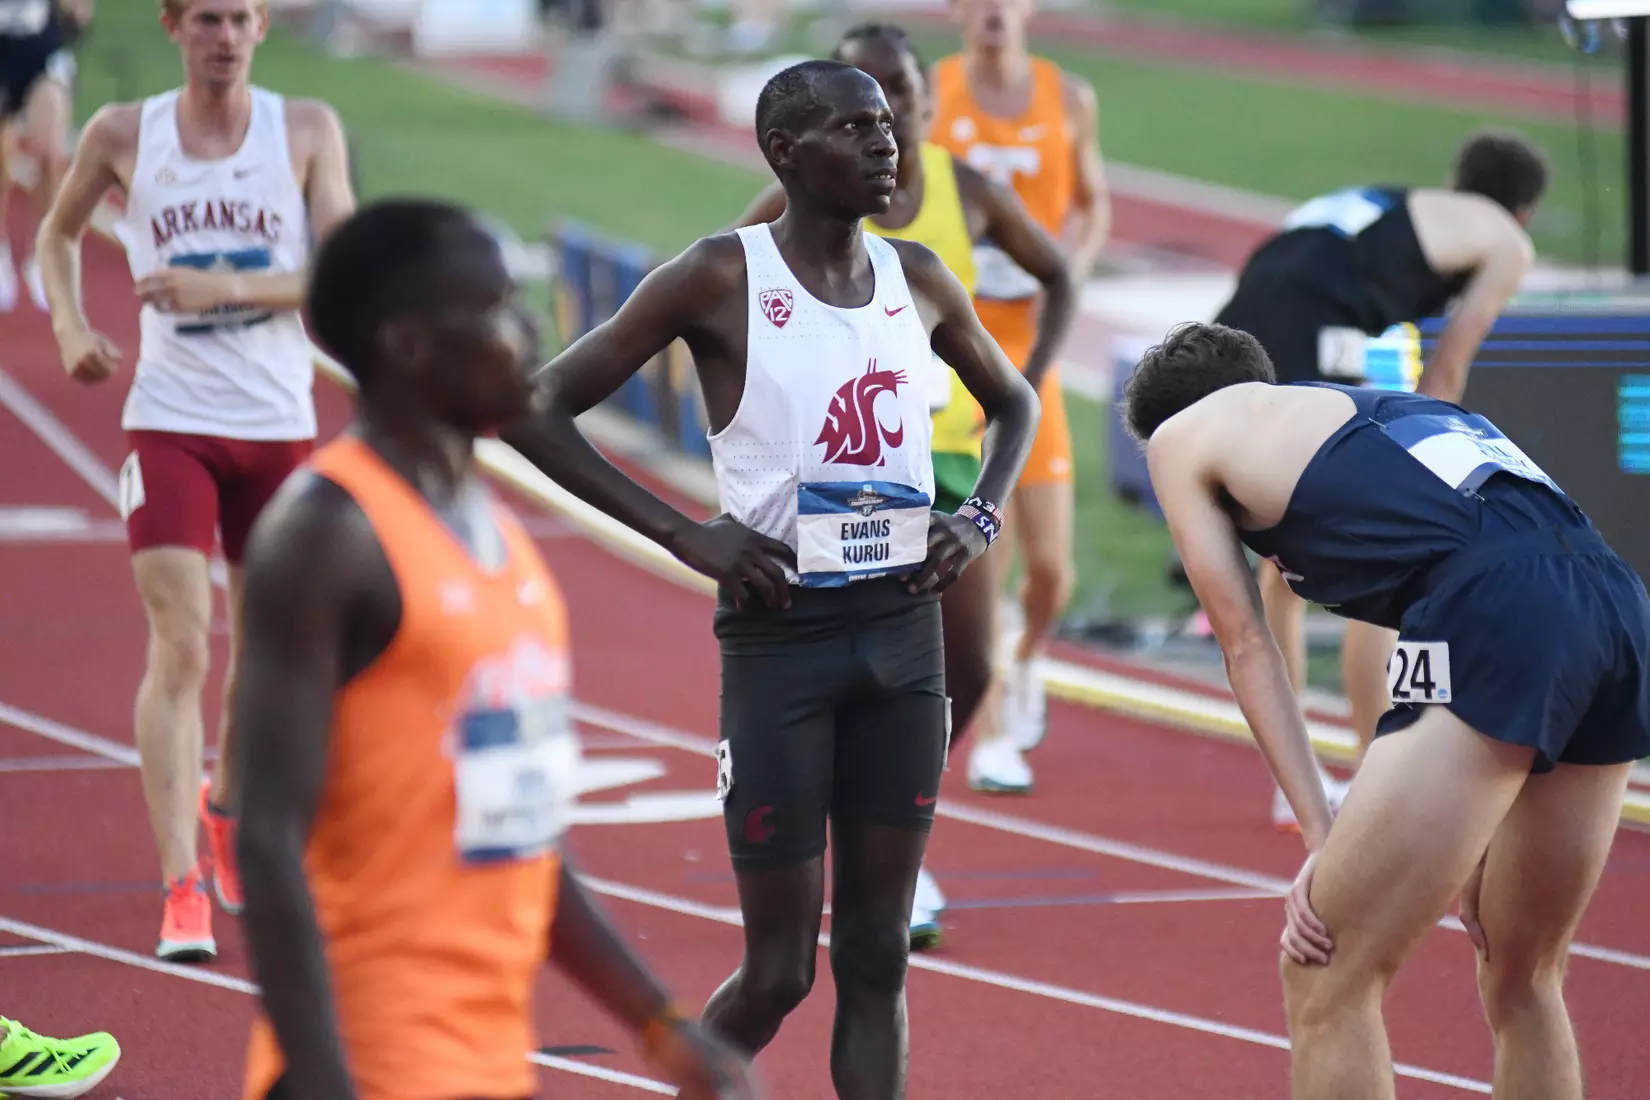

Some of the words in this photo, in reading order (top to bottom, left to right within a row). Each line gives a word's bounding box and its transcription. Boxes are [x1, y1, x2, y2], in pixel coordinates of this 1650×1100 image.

[151, 200, 282, 247] ARKANSAS
[759, 288, 793, 311] PAC
[769, 304, 788, 322] 12
[841, 519, 891, 541] EVANS
[843, 541, 890, 564] KURUI
